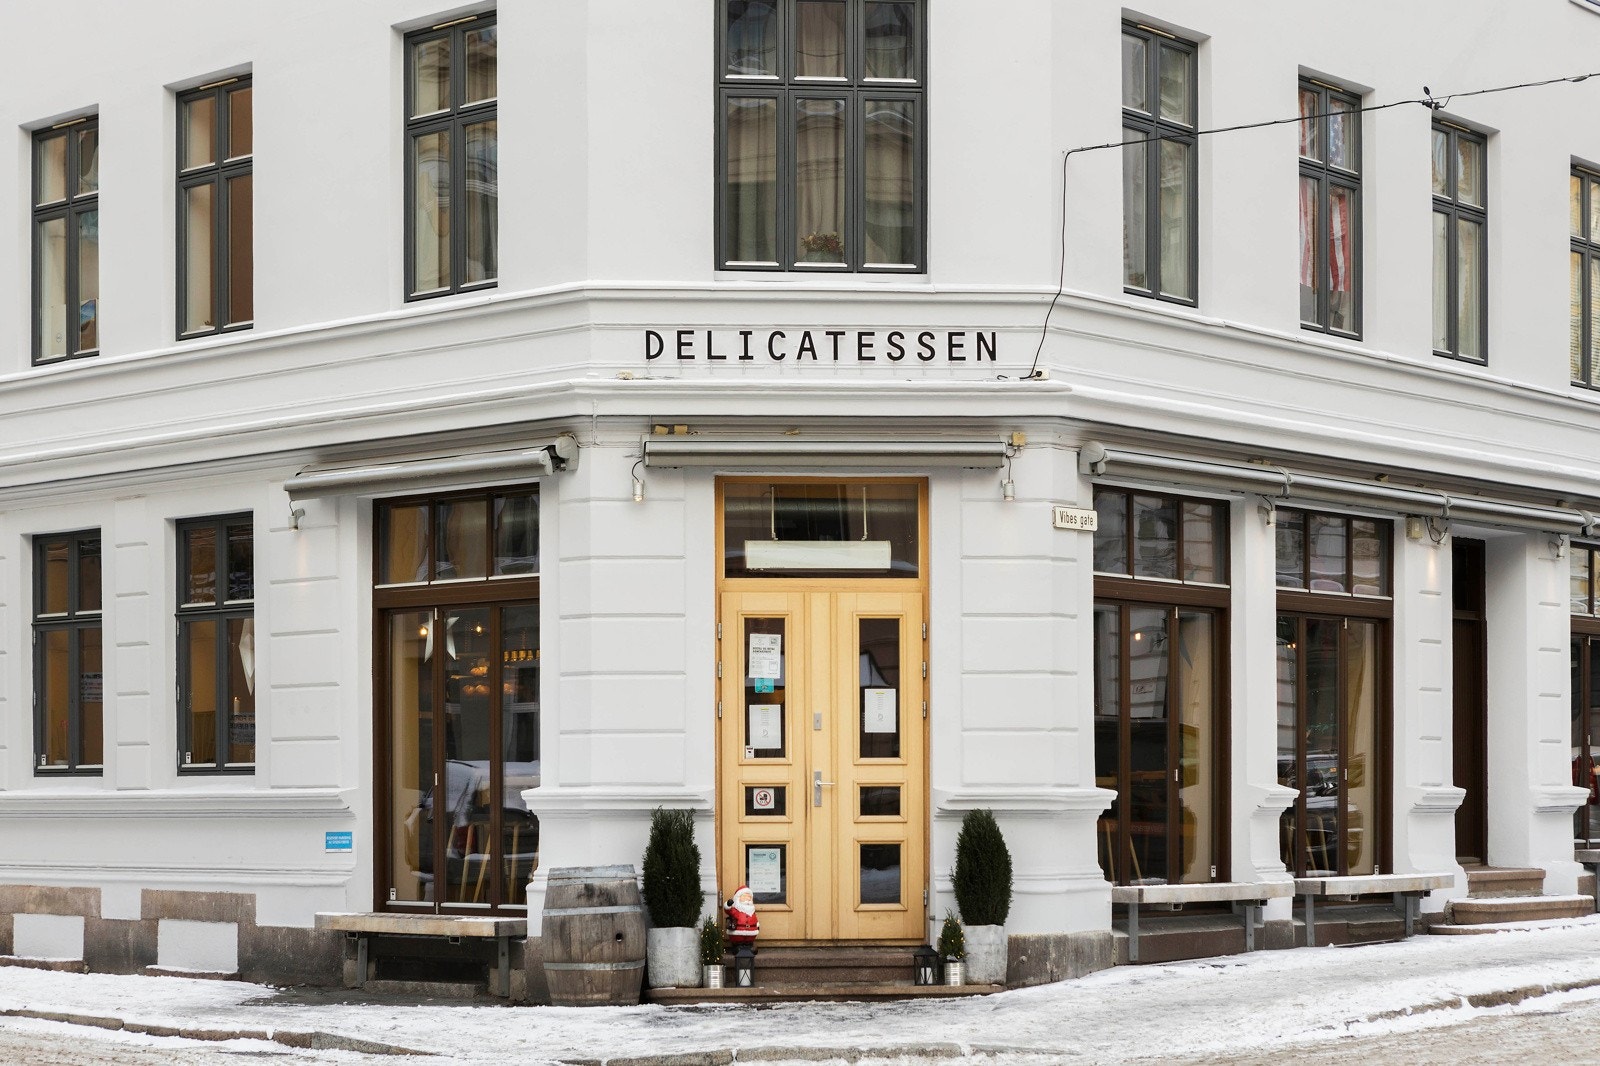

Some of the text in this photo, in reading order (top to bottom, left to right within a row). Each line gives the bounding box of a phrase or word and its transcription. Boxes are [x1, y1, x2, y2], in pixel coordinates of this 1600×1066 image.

[645, 330, 997, 362] DELICATESSEN
[1059, 510, 1094, 528] Vibes gate
